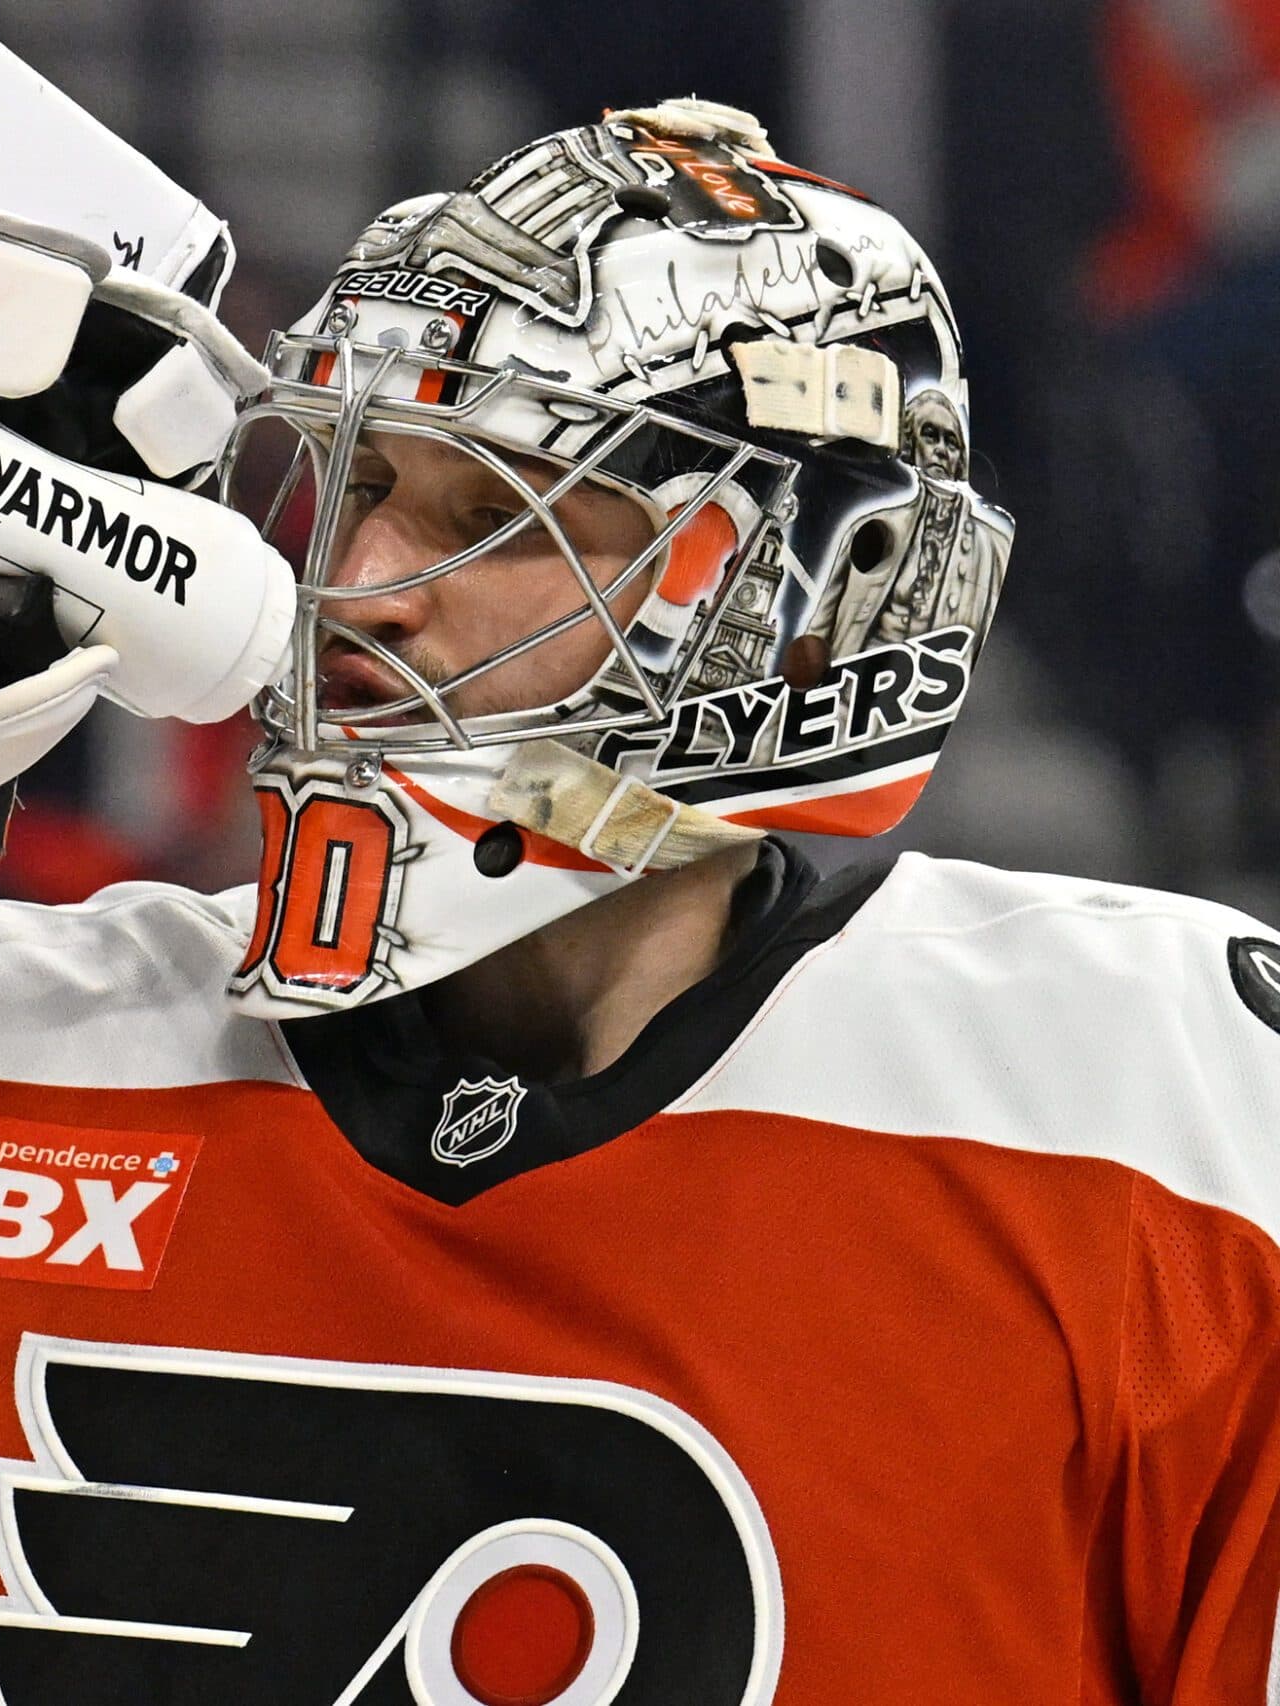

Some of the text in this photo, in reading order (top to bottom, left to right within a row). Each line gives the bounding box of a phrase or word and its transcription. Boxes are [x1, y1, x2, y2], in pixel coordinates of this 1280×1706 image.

[336, 270, 490, 317] BAUER
[582, 229, 884, 376] Philadelpia
[593, 625, 976, 775] FLYERS
[447, 1100, 504, 1150] NHL
